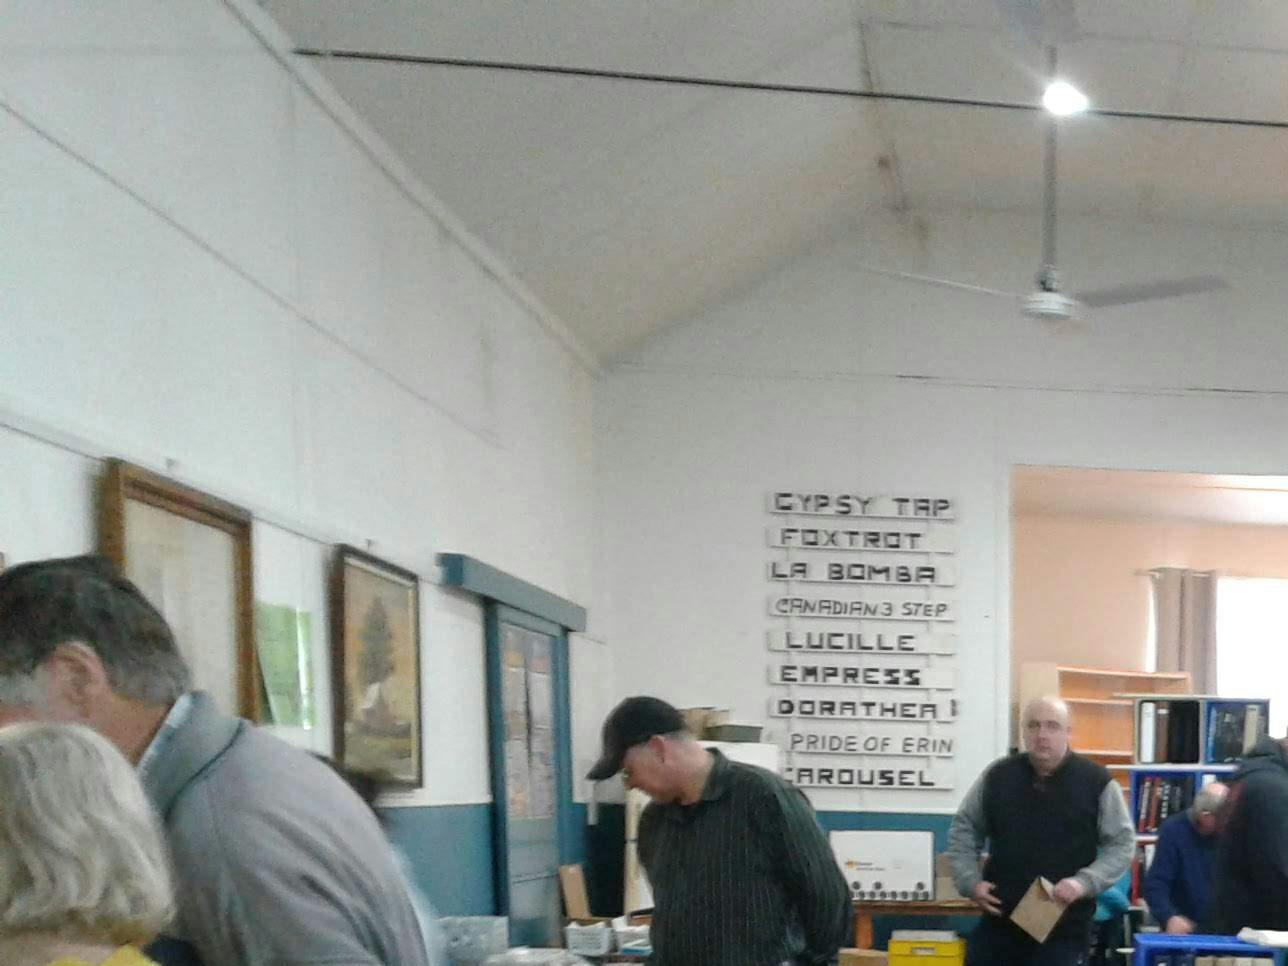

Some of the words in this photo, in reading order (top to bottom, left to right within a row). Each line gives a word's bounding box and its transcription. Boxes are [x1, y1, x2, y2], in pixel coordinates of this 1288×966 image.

[774, 492, 870, 515] GYPSY
[893, 497, 950, 518] TAP
[780, 528, 922, 549] FOXTROT
[771, 562, 808, 579] LA
[828, 563, 936, 583] BOMBA
[775, 598, 878, 616] CANADIAN
[882, 602, 893, 617] 3
[901, 602, 948, 618] STEP
[785, 631, 915, 652] LUCILLE
[780, 665, 922, 686] EMPRESS
[778, 699, 938, 720] DORATHEA
[790, 733, 858, 752] PRIDE
[863, 736, 892, 752] OF
[902, 737, 953, 754] ERIN
